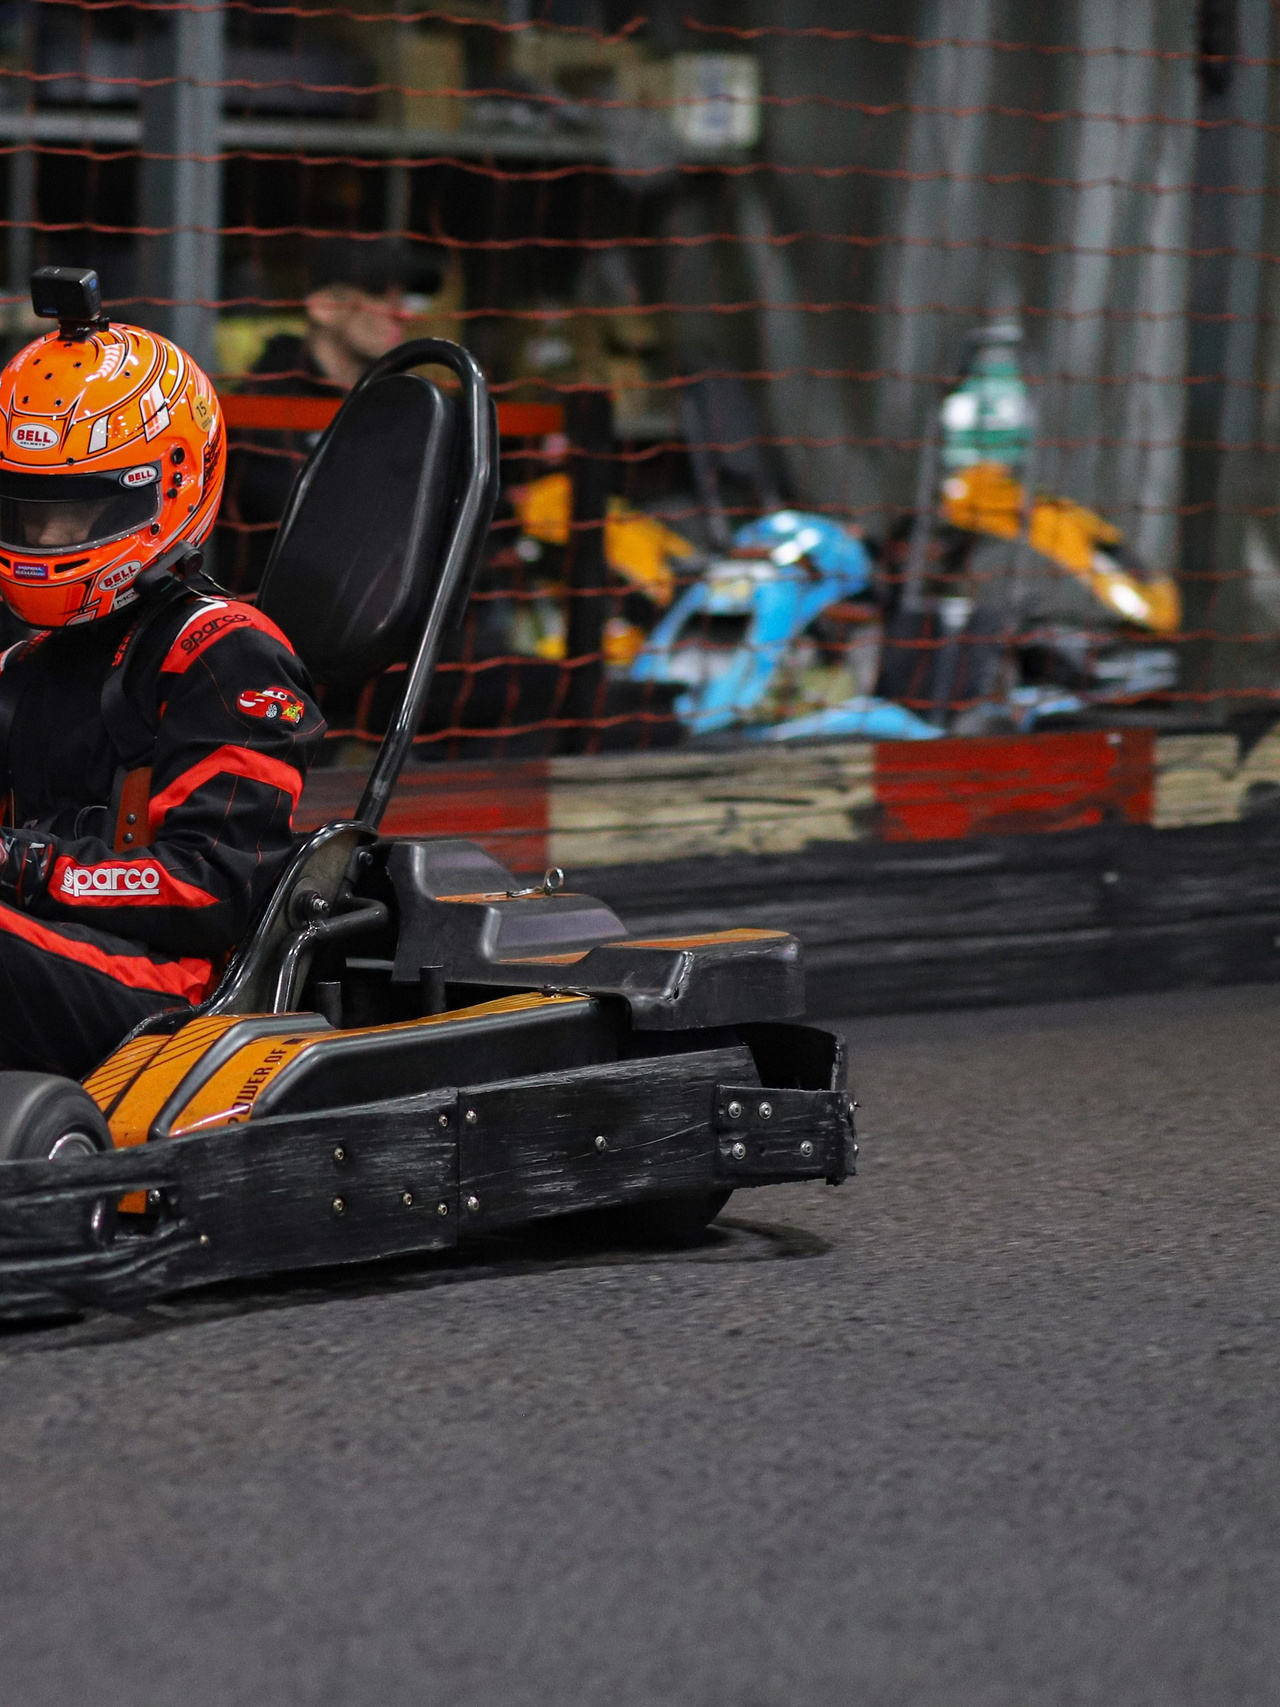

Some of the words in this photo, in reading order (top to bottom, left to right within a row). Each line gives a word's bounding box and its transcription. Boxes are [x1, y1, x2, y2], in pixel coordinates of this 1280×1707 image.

[195, 401, 208, 418] 15
[16, 429, 51, 443] BELL
[127, 470, 154, 482] BELL
[103, 565, 137, 588] BELL
[180, 614, 251, 655] sparco
[60, 866, 160, 897] sparco
[263, 1048, 287, 1063] OF
